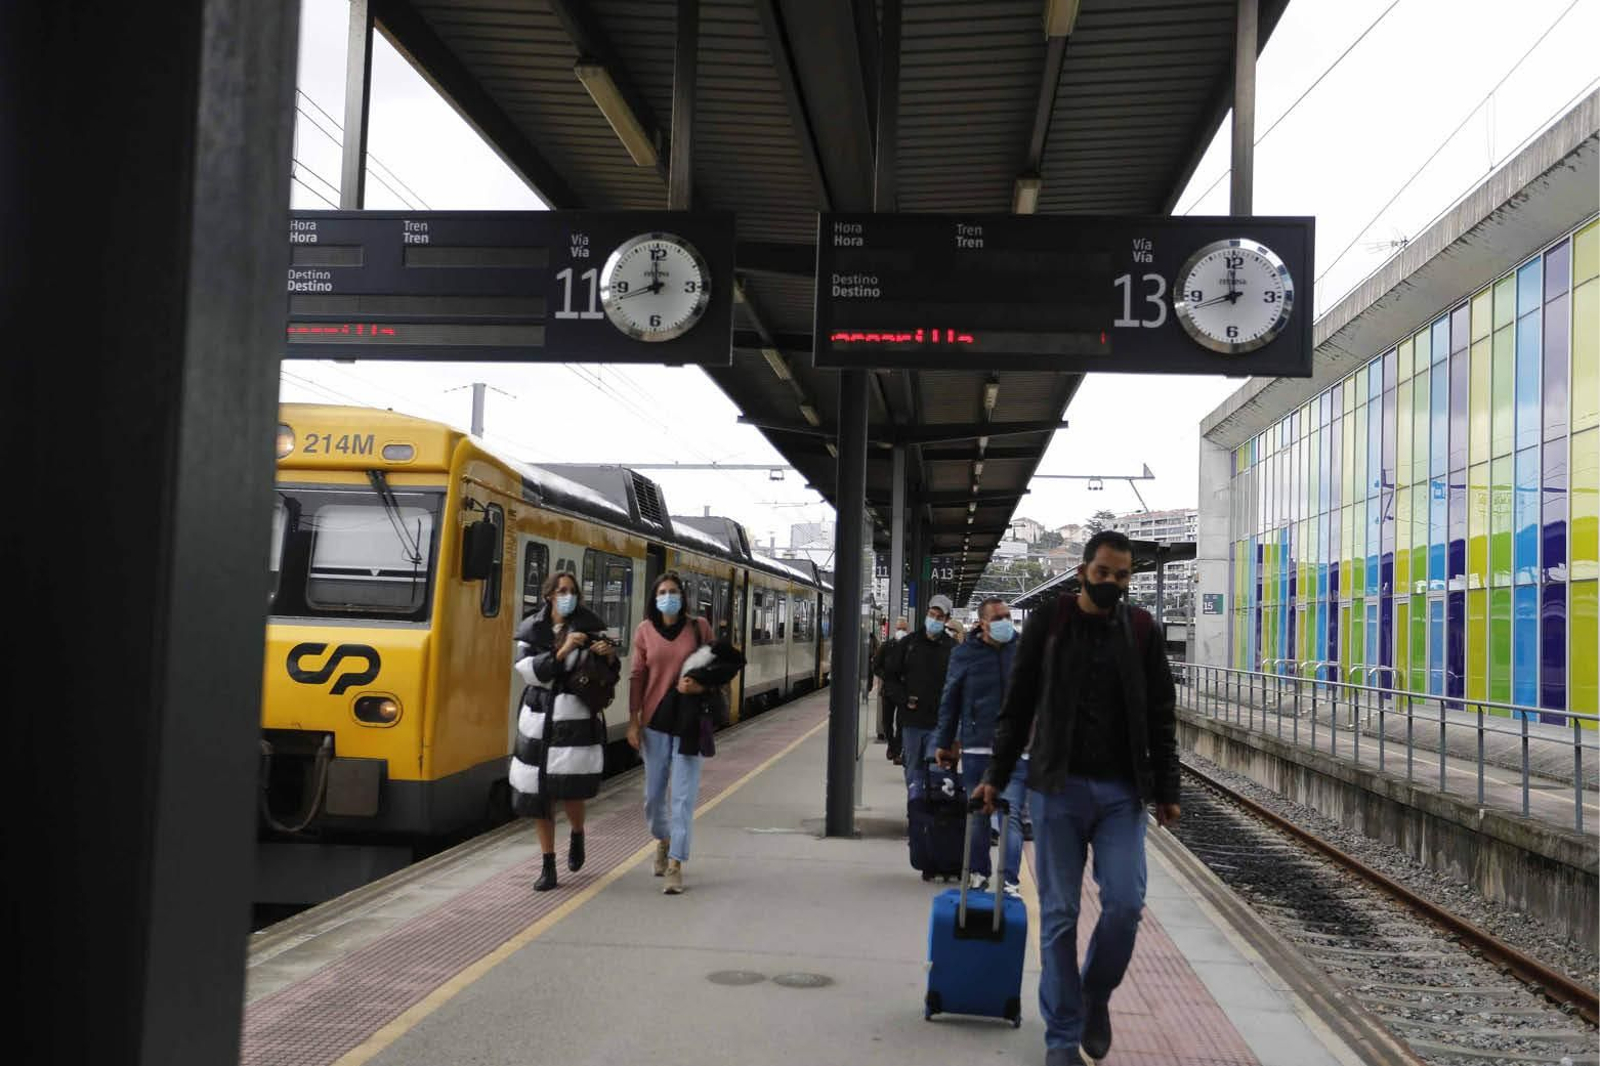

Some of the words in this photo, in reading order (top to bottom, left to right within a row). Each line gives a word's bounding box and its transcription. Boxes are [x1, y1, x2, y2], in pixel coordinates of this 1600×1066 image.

[290, 220, 317, 231] Hora
[404, 220, 428, 231] Tren
[834, 222, 862, 233] Hora
[956, 223, 982, 235] Tren
[289, 231, 318, 243] Hora
[404, 232, 429, 243] Tren
[834, 235, 863, 247] Hora
[955, 236, 983, 248] Tren
[650, 249, 667, 262] 12
[1225, 256, 1243, 270] 12
[288, 269, 331, 280] Destino
[832, 273, 878, 285] Destino
[288, 280, 333, 292] Destino
[617, 281, 629, 293] 9
[684, 281, 696, 293] 3
[832, 285, 880, 297] Destino
[555, 267, 604, 319] 11
[1191, 290, 1203, 303] 9
[1264, 291, 1276, 303] 3
[1113, 273, 1168, 328] 13
[650, 315, 662, 327] 6
[1226, 325, 1239, 338] 6
[303, 433, 375, 455] 214M
[876, 566, 889, 577] 11
[931, 568, 939, 579] A
[940, 568, 954, 580] 13
[1204, 601, 1214, 610] 15
